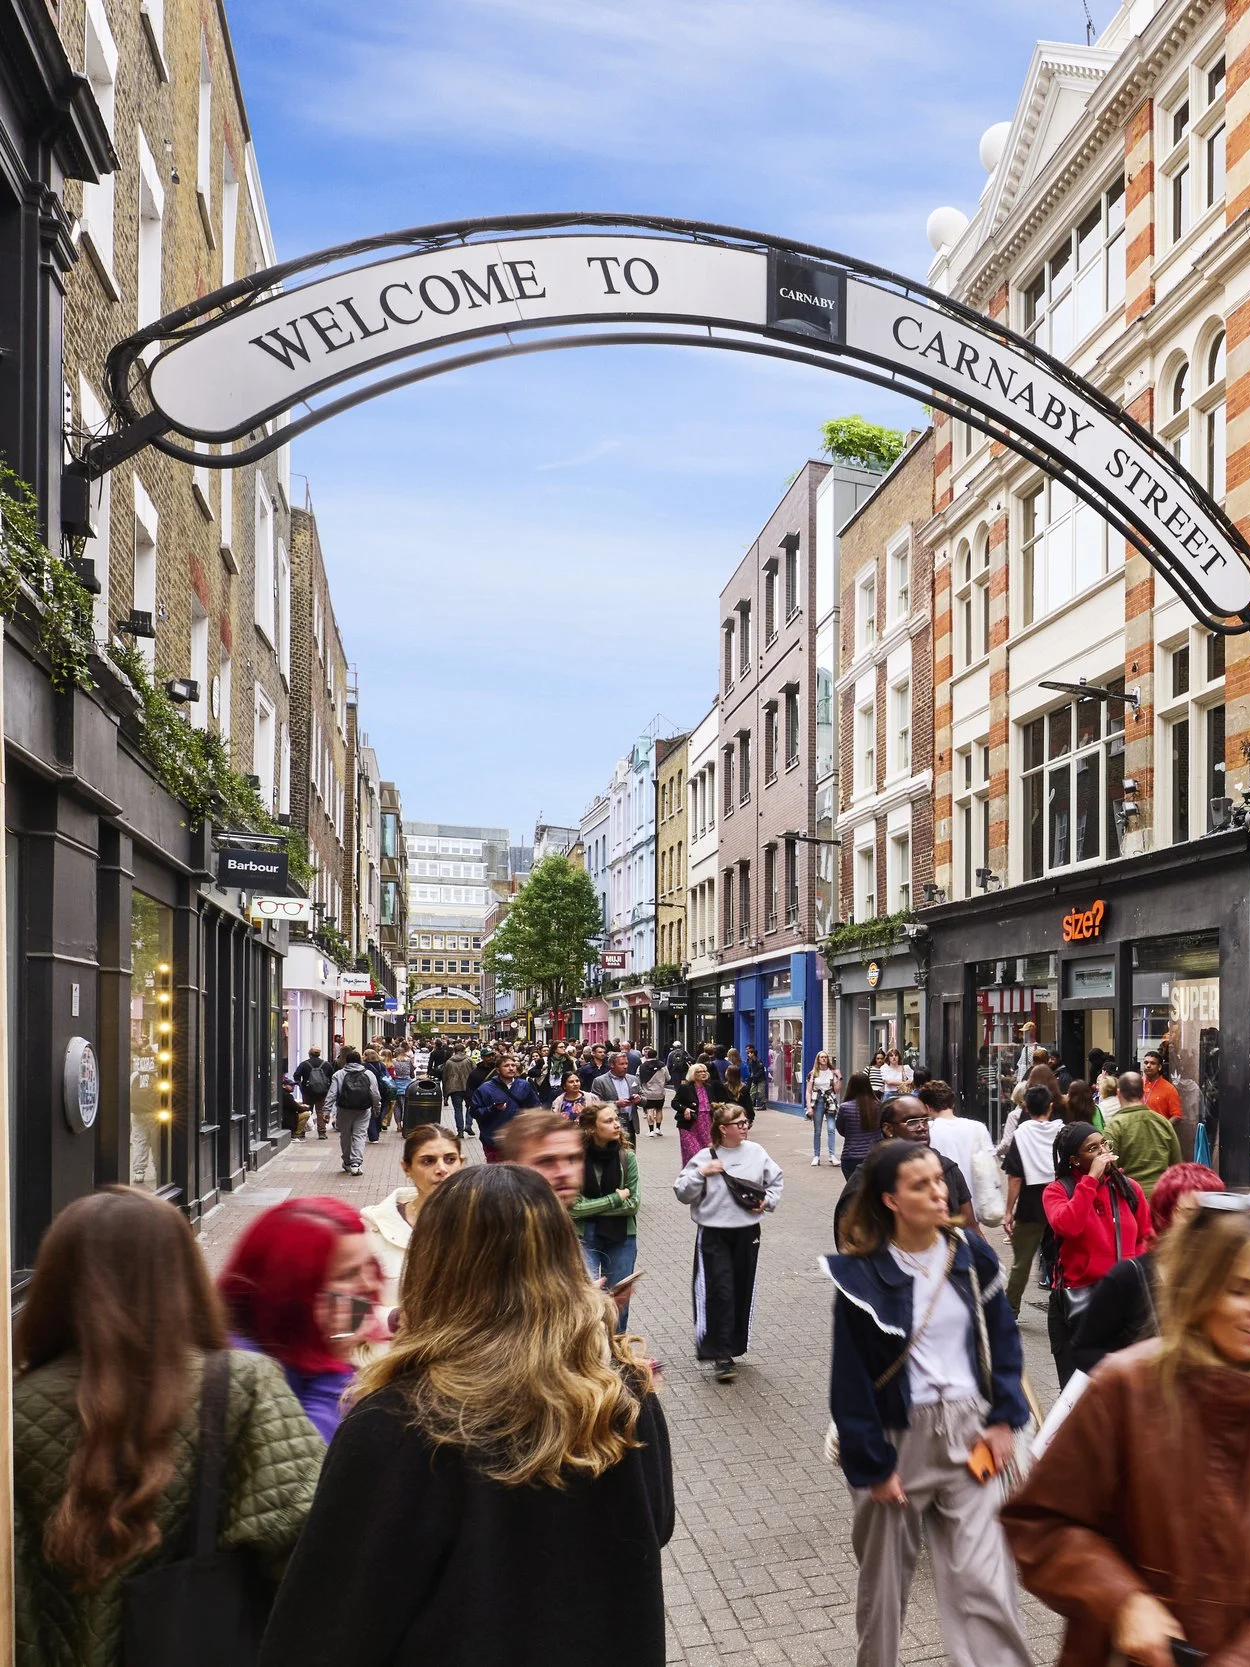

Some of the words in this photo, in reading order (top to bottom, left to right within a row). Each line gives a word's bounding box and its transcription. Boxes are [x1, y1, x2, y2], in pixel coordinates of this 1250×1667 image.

[249, 260, 546, 371] WELCOME
[586, 256, 660, 296] TO
[779, 287, 835, 310] CARNABY
[892, 315, 1095, 446] CARNABY
[1105, 448, 1227, 576] STREET
[227, 859, 279, 873] Barbour
[1062, 899, 1105, 942] size?
[605, 955, 622, 963] MUJI
[1171, 985, 1219, 1021] SUPER
